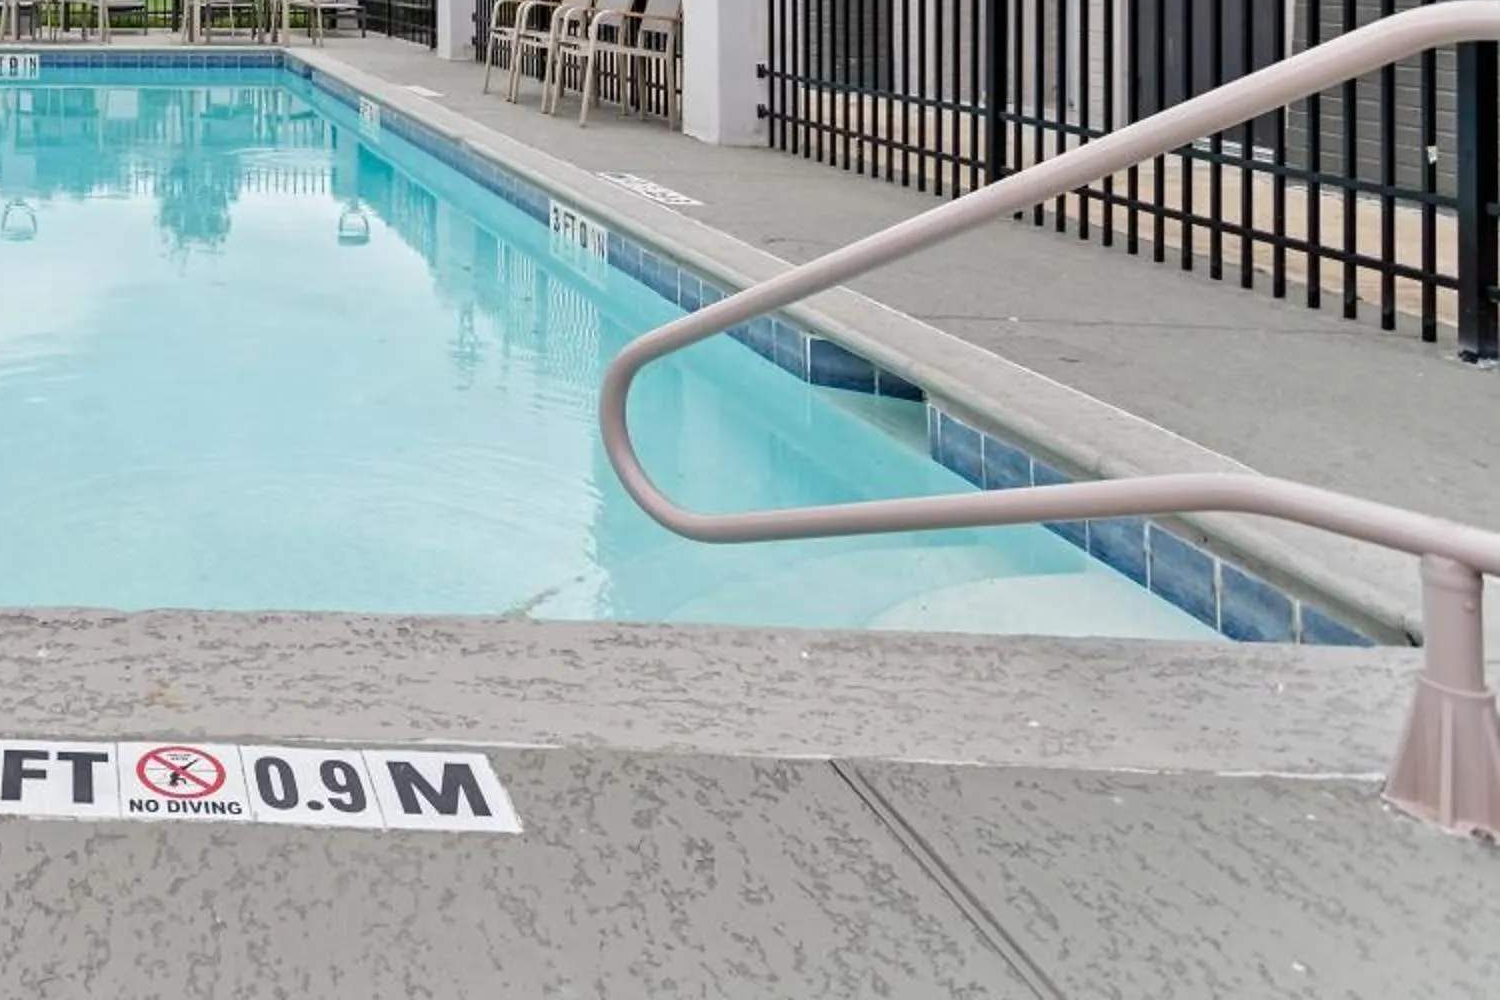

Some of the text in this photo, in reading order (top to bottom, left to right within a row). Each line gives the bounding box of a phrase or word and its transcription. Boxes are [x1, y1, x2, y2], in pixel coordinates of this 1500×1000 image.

[1, 750, 109, 804] FT
[254, 757, 367, 813] 0.9
[387, 761, 492, 817] M
[129, 799, 243, 815] NO DIVING
